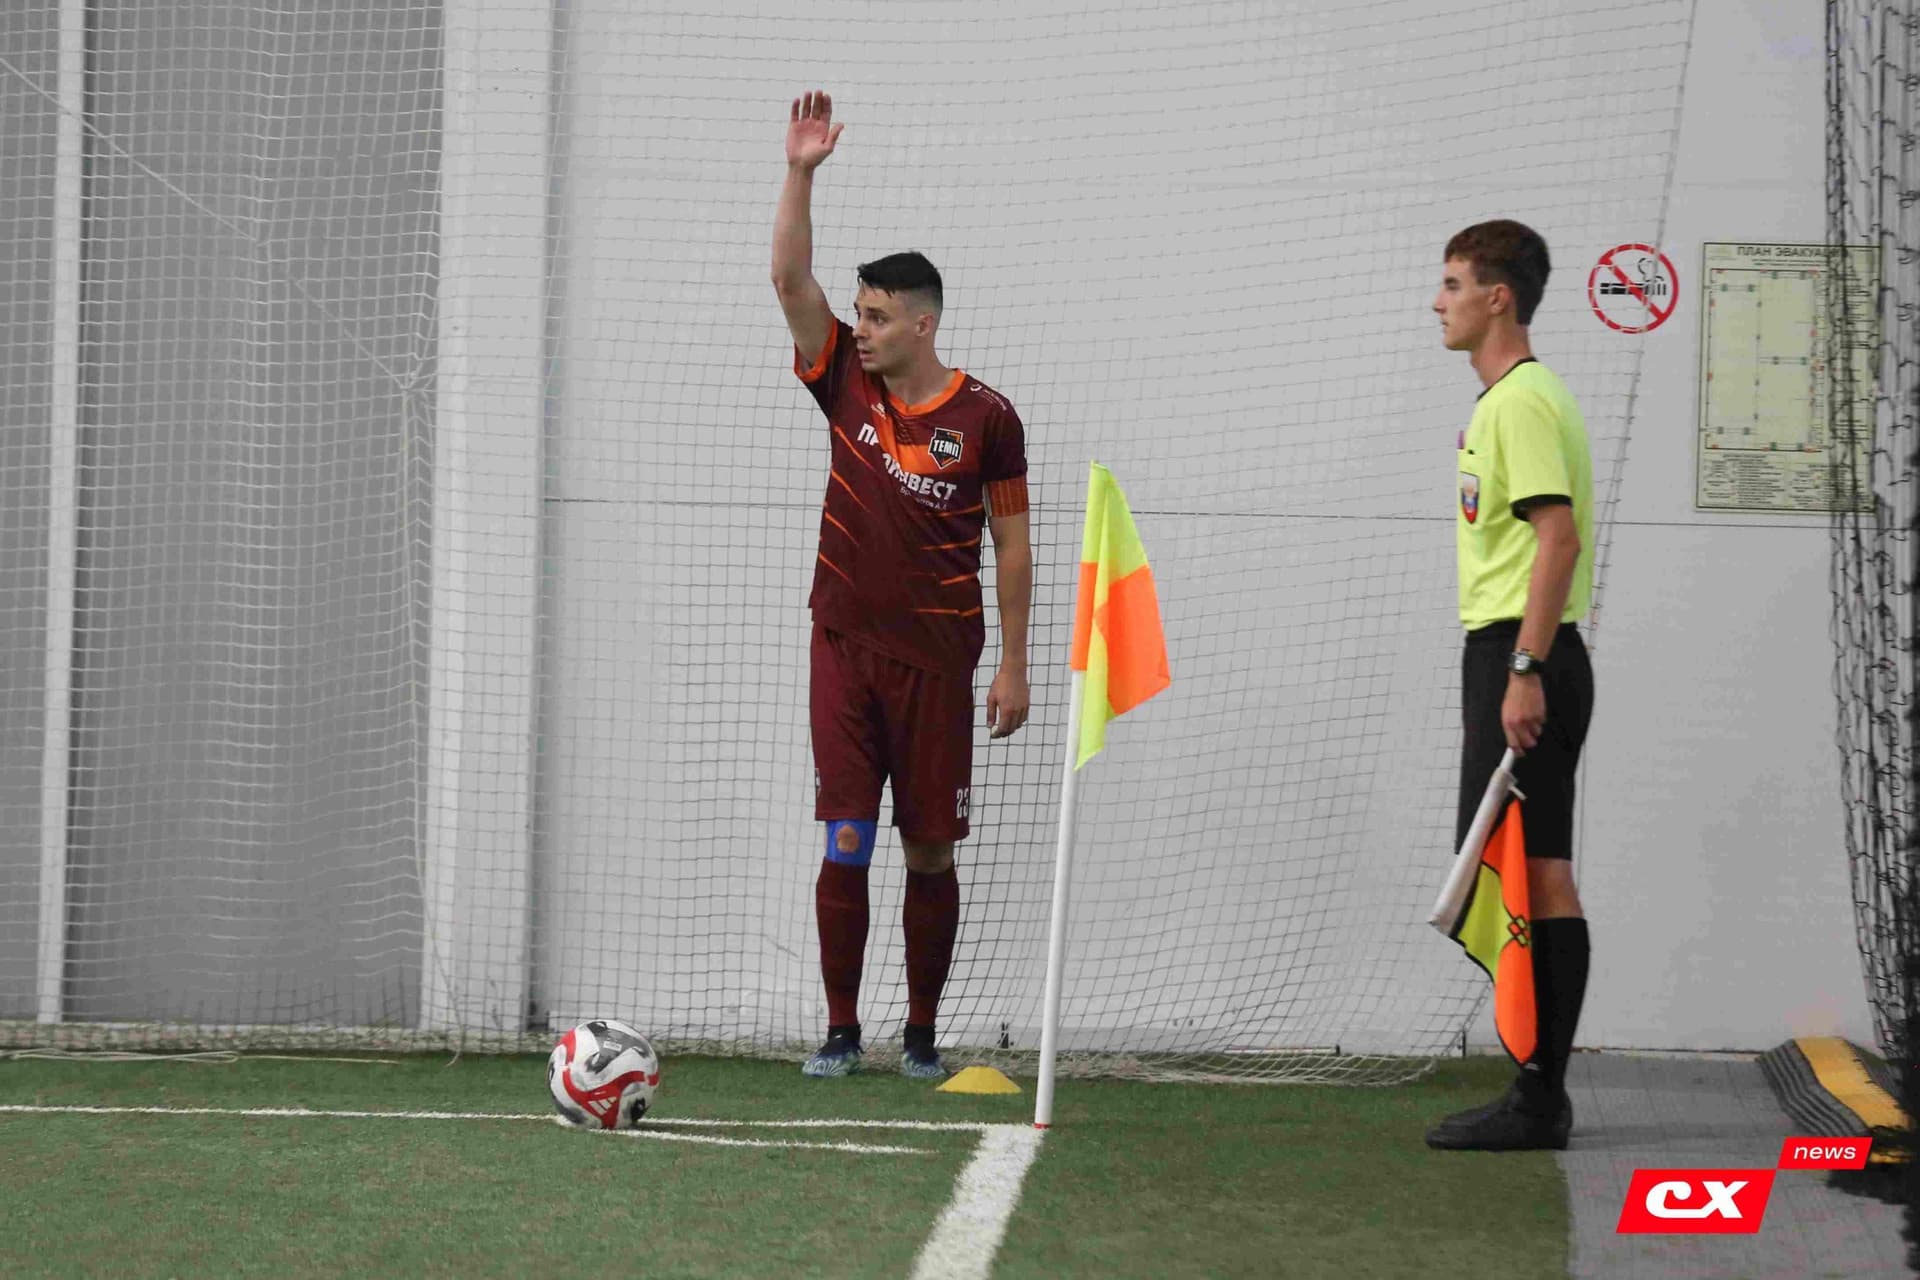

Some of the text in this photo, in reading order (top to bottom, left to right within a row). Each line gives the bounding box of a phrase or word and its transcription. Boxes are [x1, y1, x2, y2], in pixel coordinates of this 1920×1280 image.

[1737, 246, 1847, 258] ПЛАН ЭВАКУАИ
[933, 439, 960, 457] ТЕМП
[956, 788, 969, 819] 23
